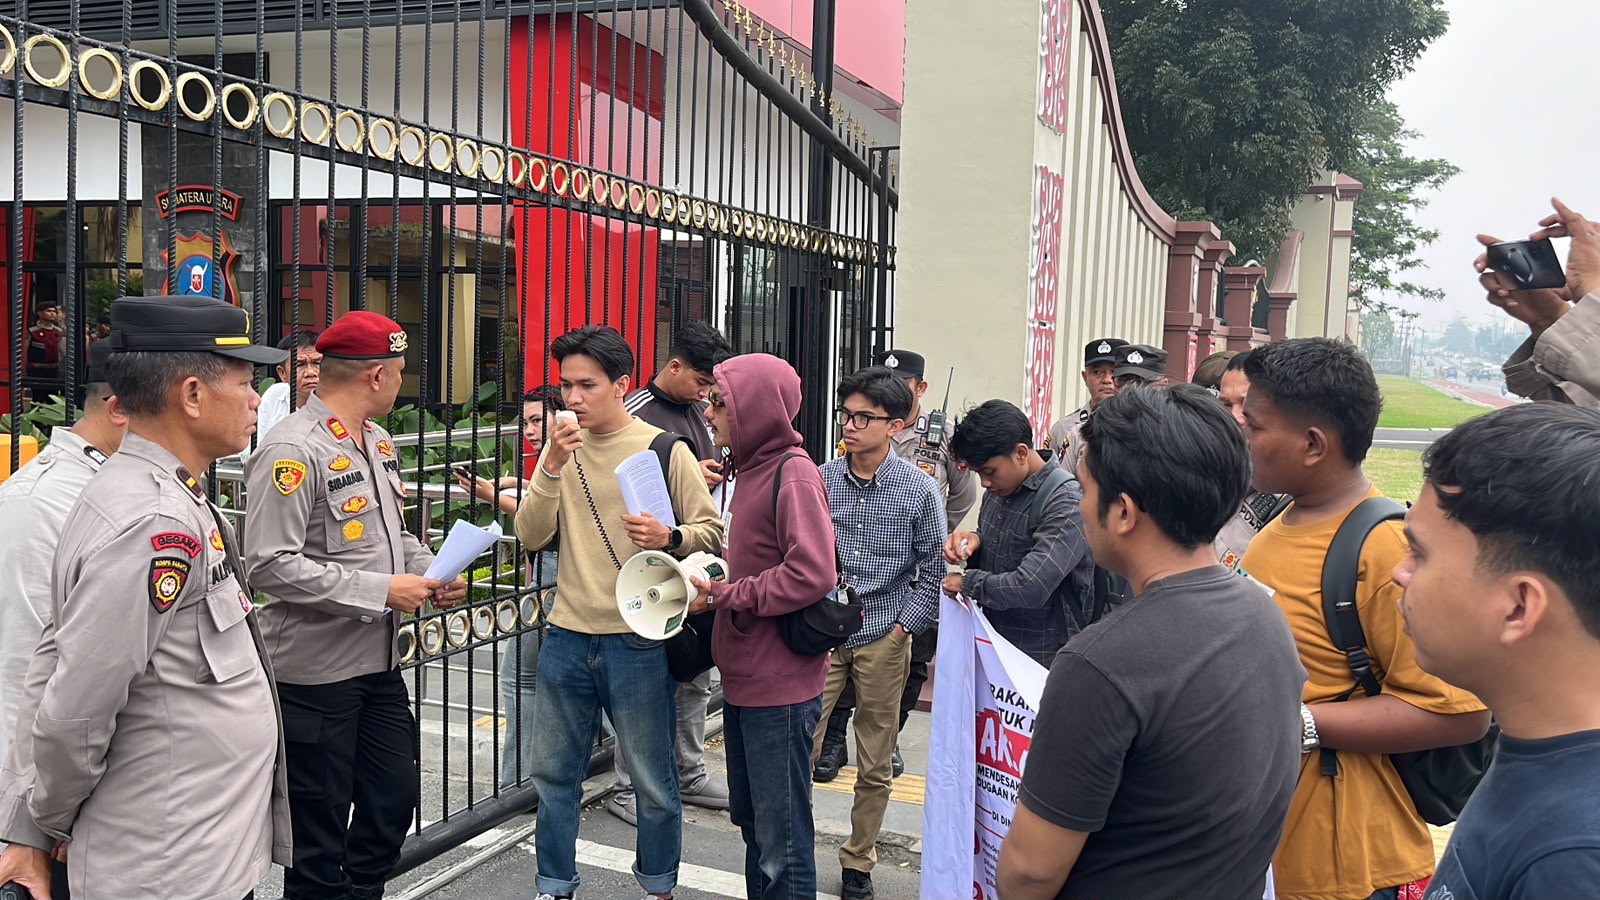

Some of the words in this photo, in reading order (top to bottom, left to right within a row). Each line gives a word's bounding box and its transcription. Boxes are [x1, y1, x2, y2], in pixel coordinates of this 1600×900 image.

[914, 448, 940, 460] POLRI
[158, 535, 198, 552] GEGANA
[976, 776, 1009, 801] DUGAAN
[992, 811, 1000, 822] DI
